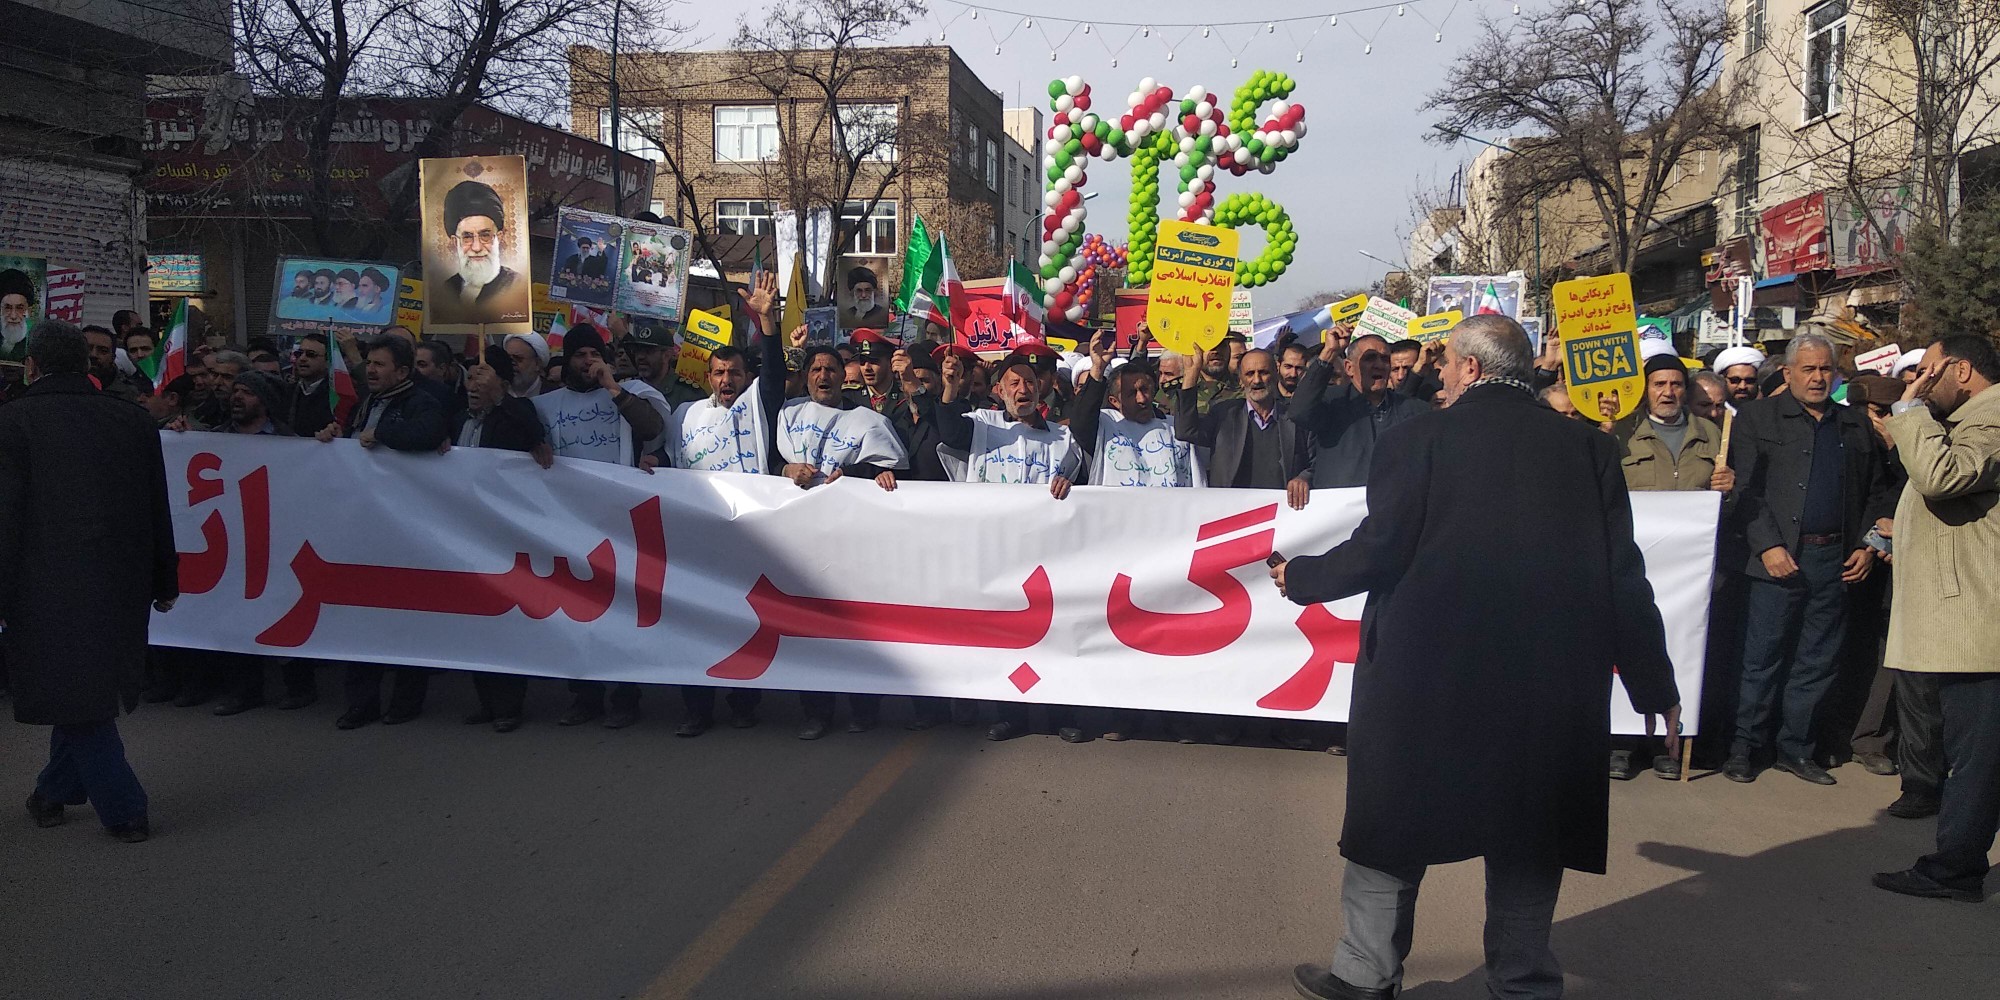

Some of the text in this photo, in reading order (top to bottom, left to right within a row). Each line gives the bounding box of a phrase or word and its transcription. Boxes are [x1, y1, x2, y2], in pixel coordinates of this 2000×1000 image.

[1160, 247, 1233, 269] به کوری چشم آمریکا
[1156, 267, 1231, 287] انقلاب اسلامی
[1155, 293, 1173, 304] شد
[1175, 295, 1198, 309] ساله
[533, 317, 552, 333] US
[967, 317, 1015, 349] رائیل
[1572, 335, 1629, 352] DOWN WITH
[1573, 346, 1632, 380] USA
[176, 452, 1362, 712] رگ بر اسرائ
